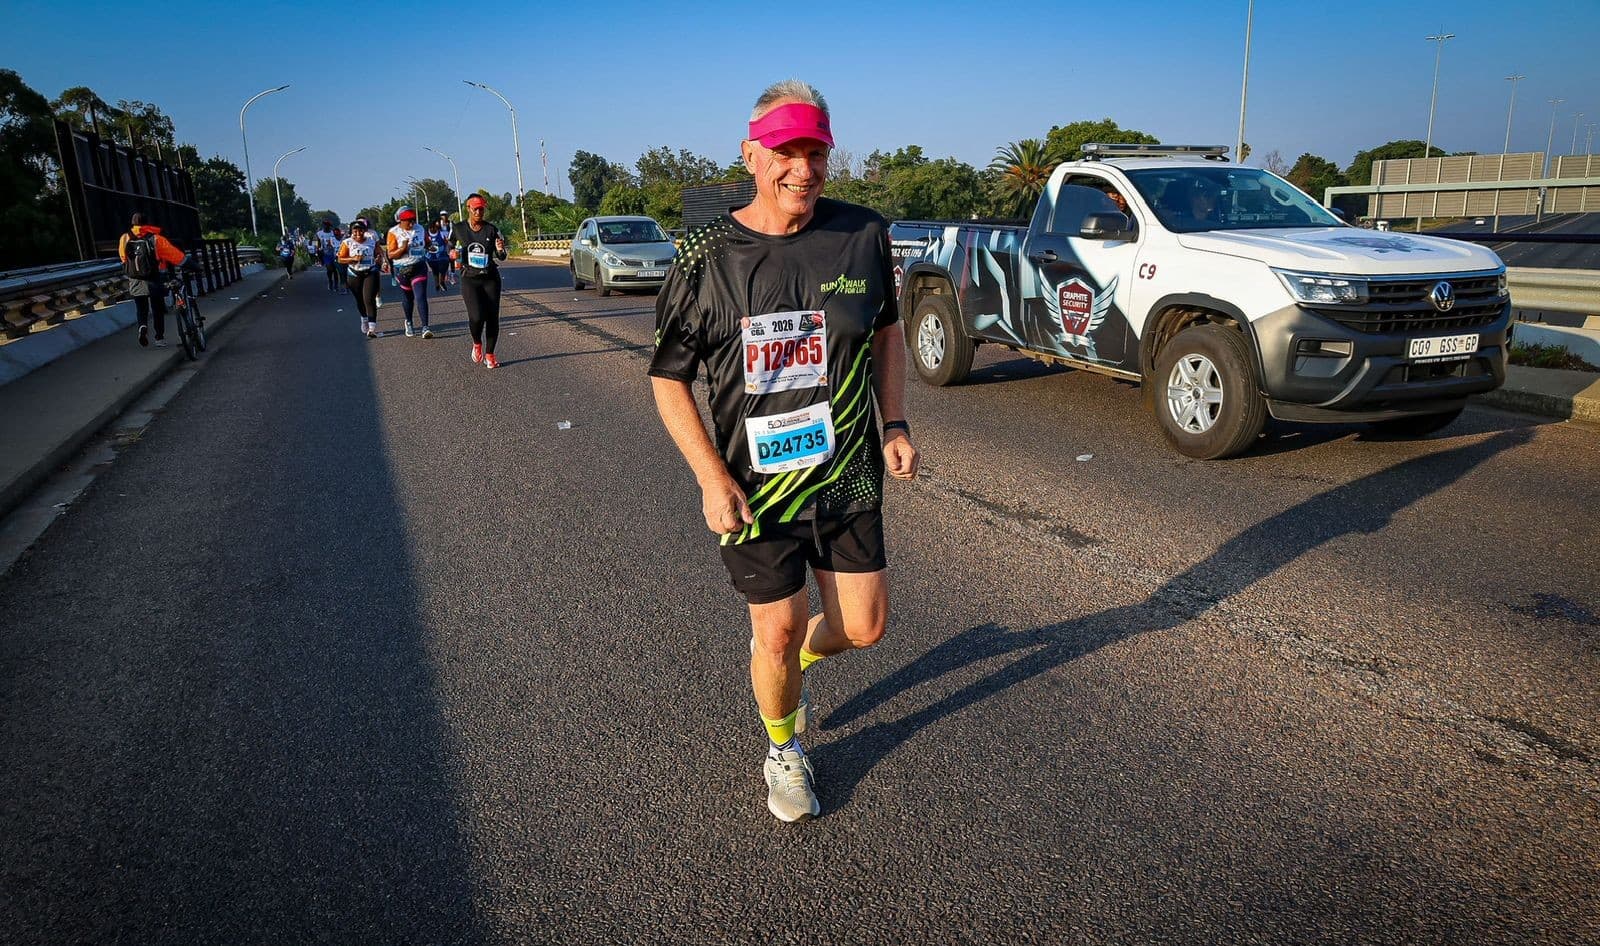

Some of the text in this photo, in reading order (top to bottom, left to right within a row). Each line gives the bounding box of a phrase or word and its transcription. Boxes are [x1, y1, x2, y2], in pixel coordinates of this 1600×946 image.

[1139, 263, 1157, 280] C9
[820, 279, 867, 293] RUN WALK
[1062, 291, 1088, 302] GRAPHITE
[1062, 299, 1088, 309] SECURITY
[772, 319, 794, 333] 2026
[1440, 338, 1458, 353] GSS
[1465, 335, 1477, 351] GP
[746, 336, 823, 373] P12965
[757, 429, 826, 459] D24735
